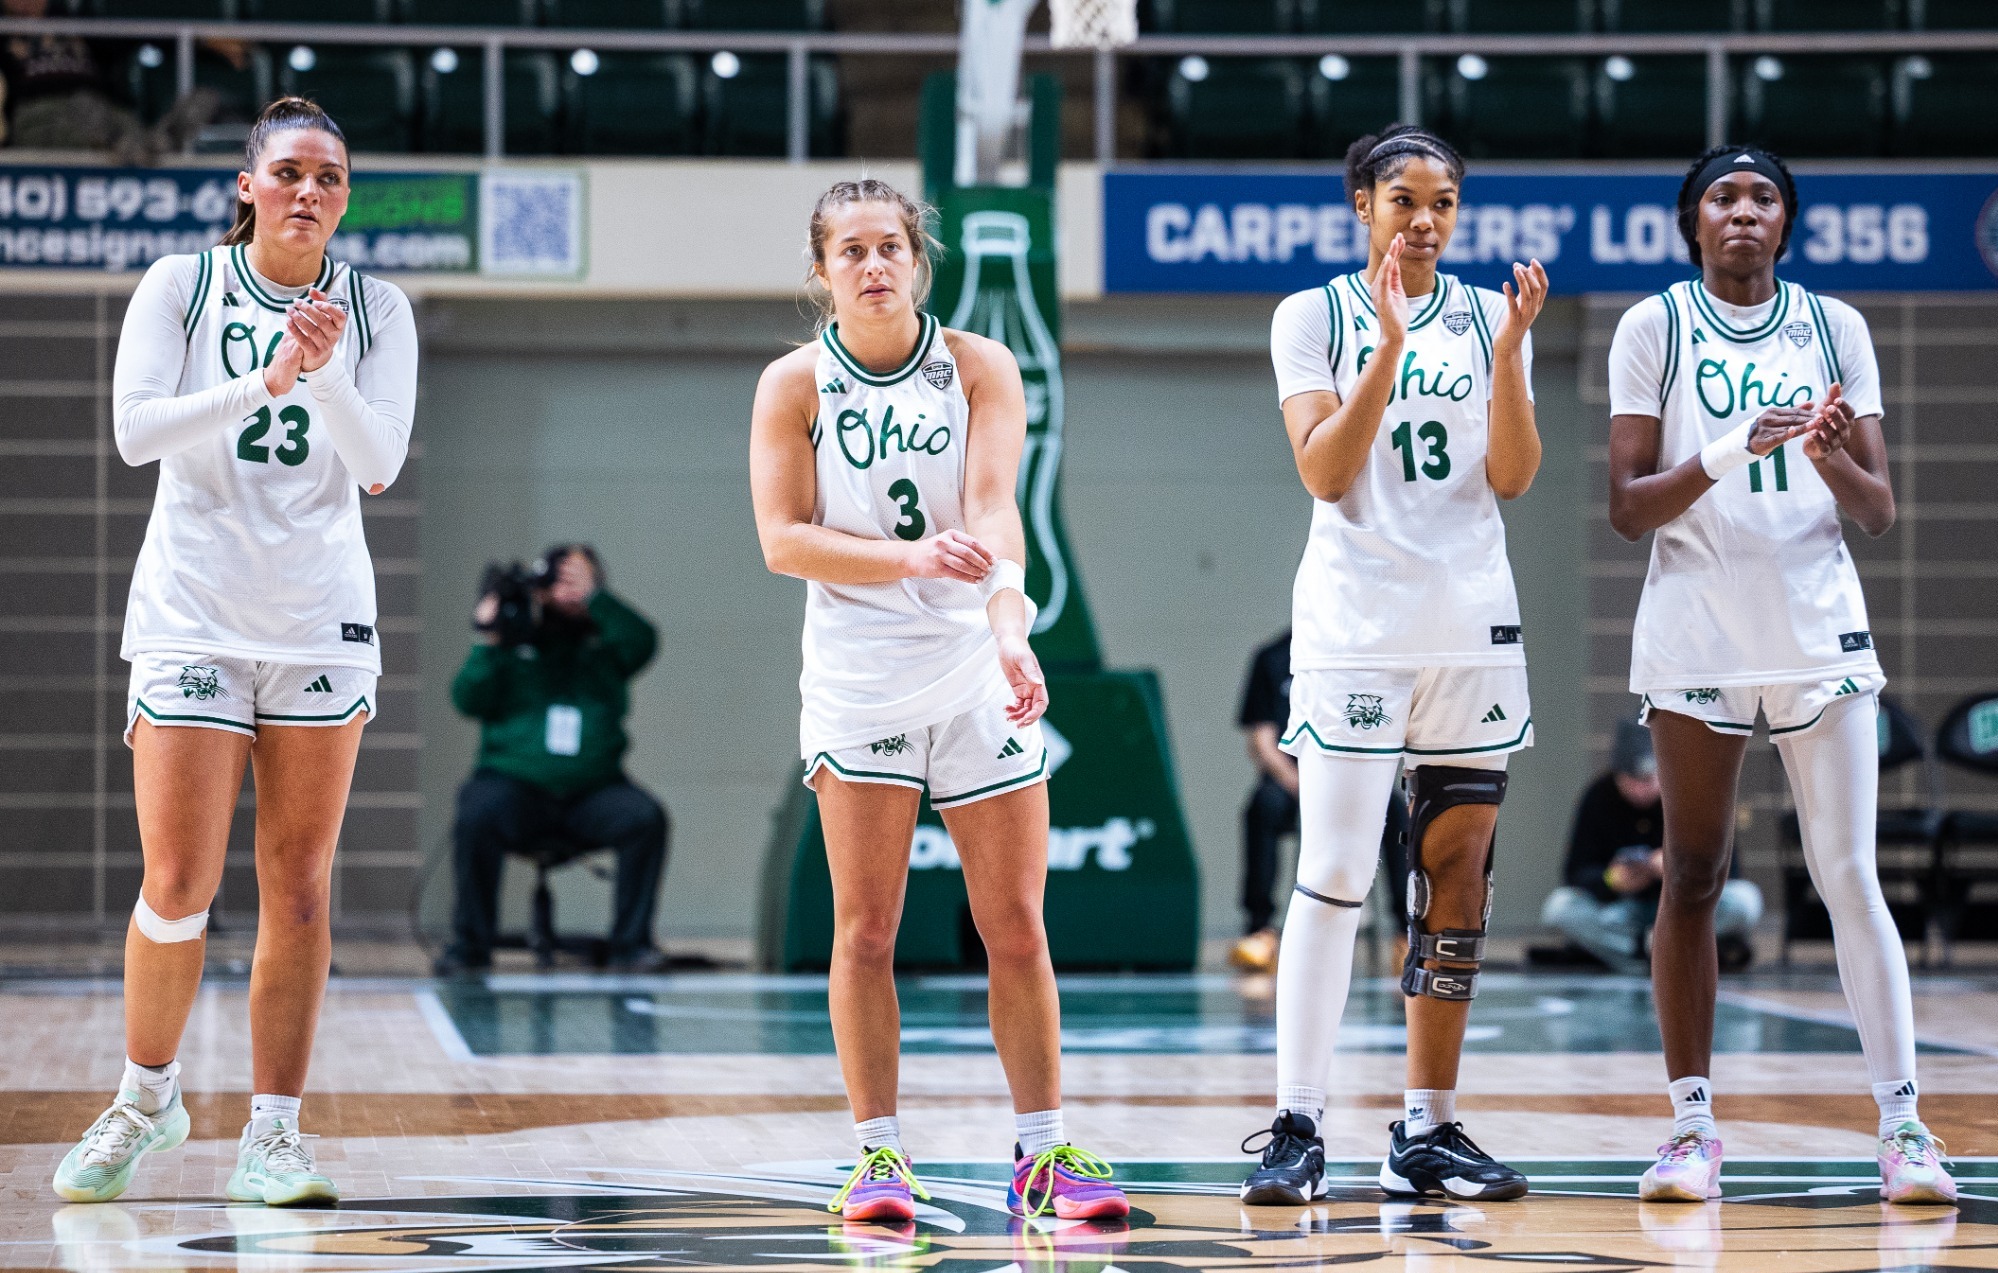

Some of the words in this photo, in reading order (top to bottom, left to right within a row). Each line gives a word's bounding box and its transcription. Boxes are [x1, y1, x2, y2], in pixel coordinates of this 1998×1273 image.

[1146, 203, 1575, 263] CARPEERS'
[1804, 204, 1929, 264] 356
[1786, 329, 1812, 337] MAC
[925, 369, 952, 380] MAC
[1696, 358, 1812, 419] Ohio
[237, 405, 310, 466] 23
[836, 405, 950, 469] Ohio
[1391, 420, 1451, 482] 13
[887, 478, 926, 541] 3
